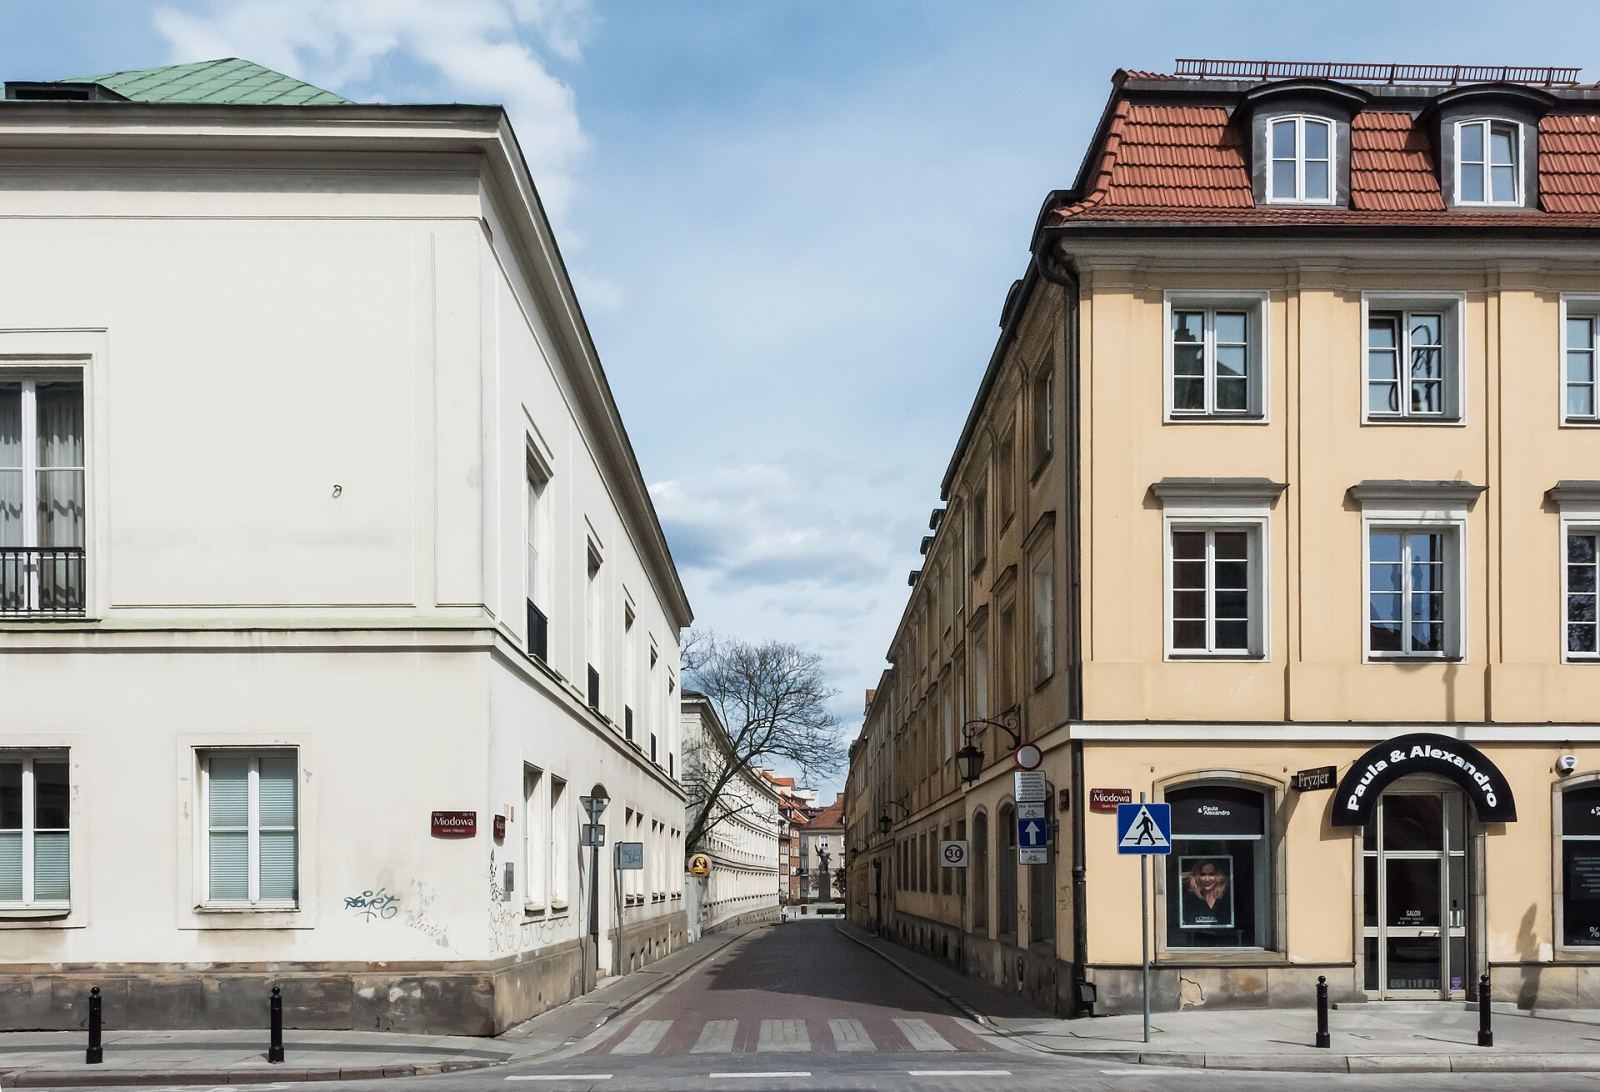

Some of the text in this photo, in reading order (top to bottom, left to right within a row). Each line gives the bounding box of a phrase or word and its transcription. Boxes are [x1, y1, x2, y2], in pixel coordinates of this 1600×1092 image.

[1298, 771, 1330, 790] Fryzjer
[1347, 745, 1497, 811] Paula & Alexandro
[1093, 793, 1130, 802] Miodowa
[433, 816, 474, 826] Miodowa
[947, 849, 961, 858] 30
[1589, 926, 1600, 937] %
